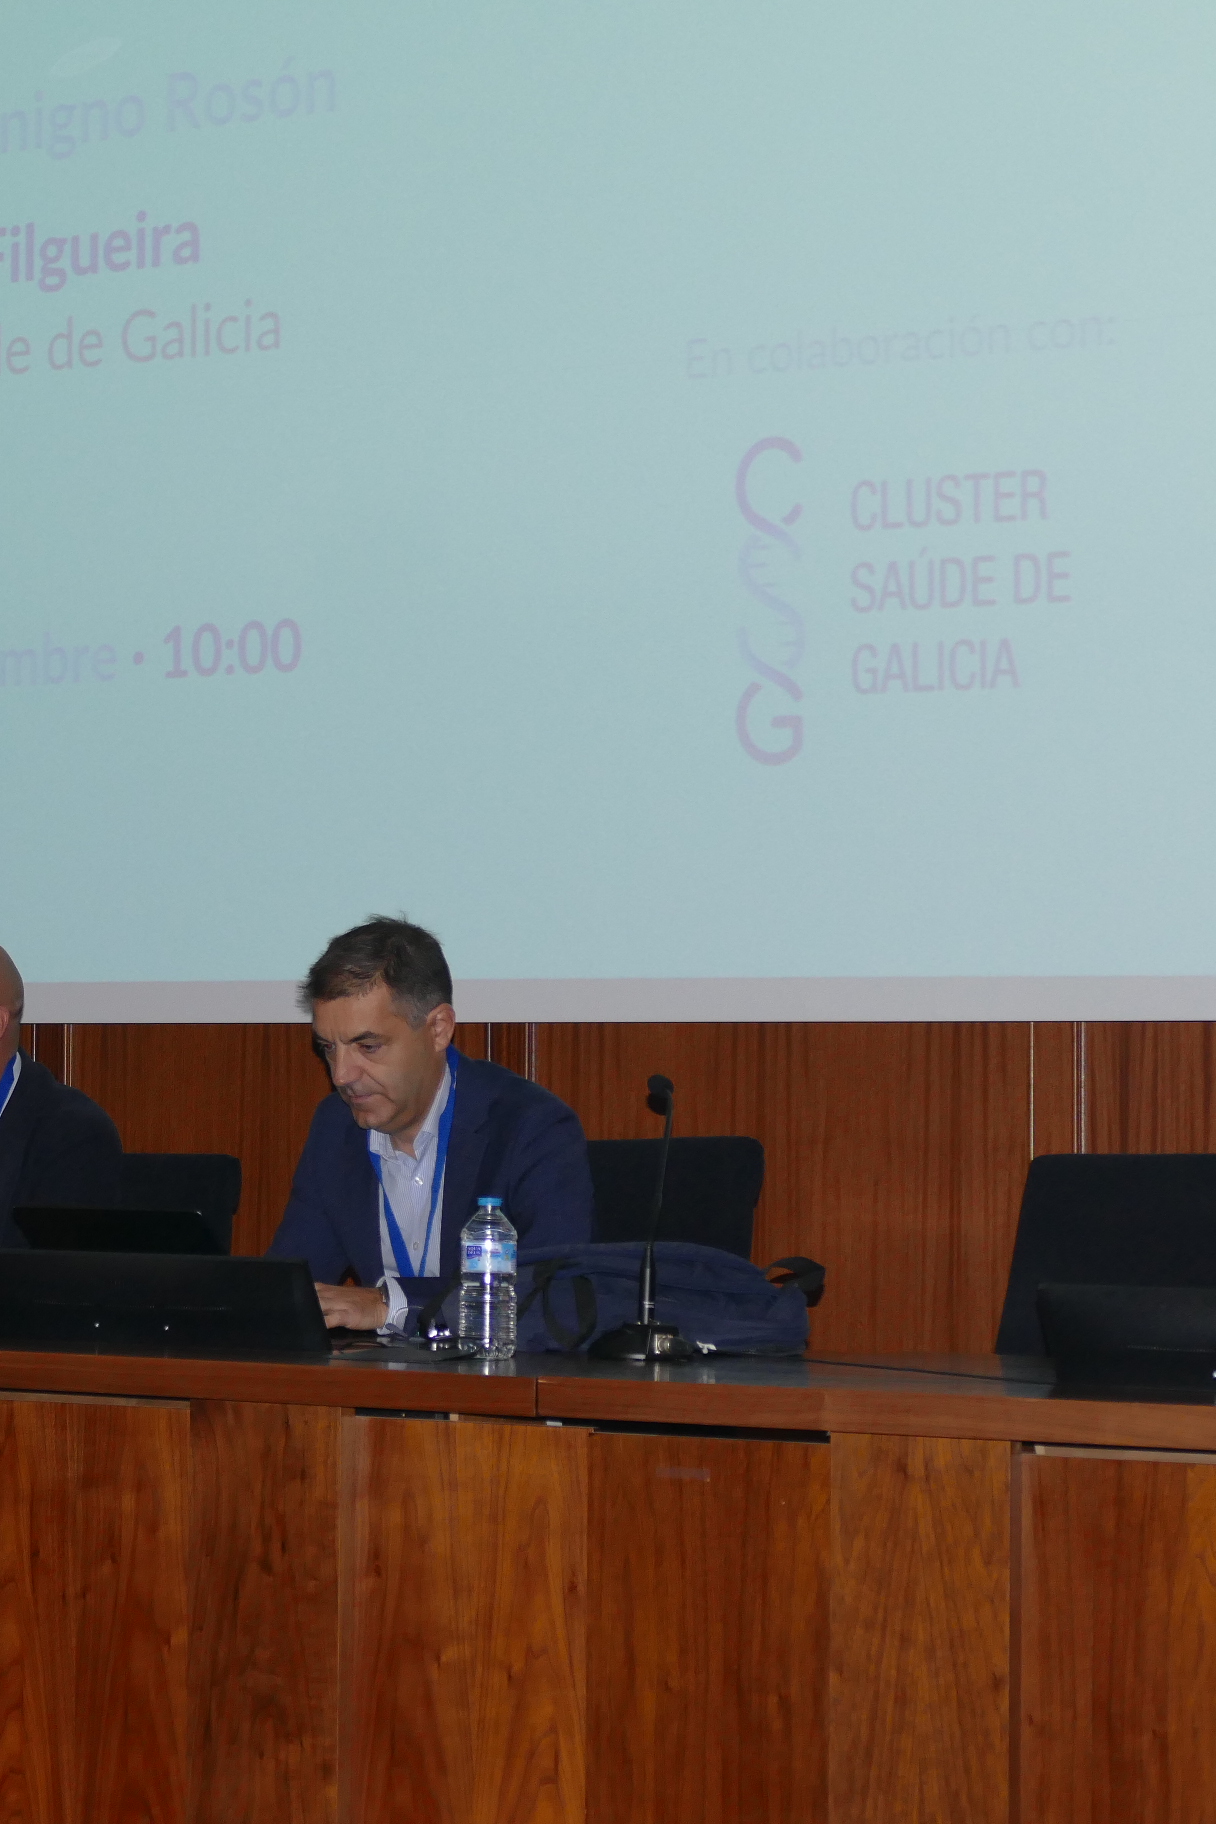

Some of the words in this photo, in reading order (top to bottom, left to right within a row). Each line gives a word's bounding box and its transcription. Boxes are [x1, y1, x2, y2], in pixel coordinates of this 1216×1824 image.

[167, 56, 338, 133] Rosón
[47, 317, 104, 370] de
[121, 298, 283, 364] Galicia
[685, 336, 734, 379] En
[747, 315, 1011, 374] colaboración
[1027, 313, 1118, 352] con:
[850, 468, 1049, 532] CLUSTER
[850, 546, 997, 613] SAÚDE
[1013, 551, 1072, 604] DE
[162, 617, 303, 680] 10:00
[850, 637, 1021, 694] GALICIA
